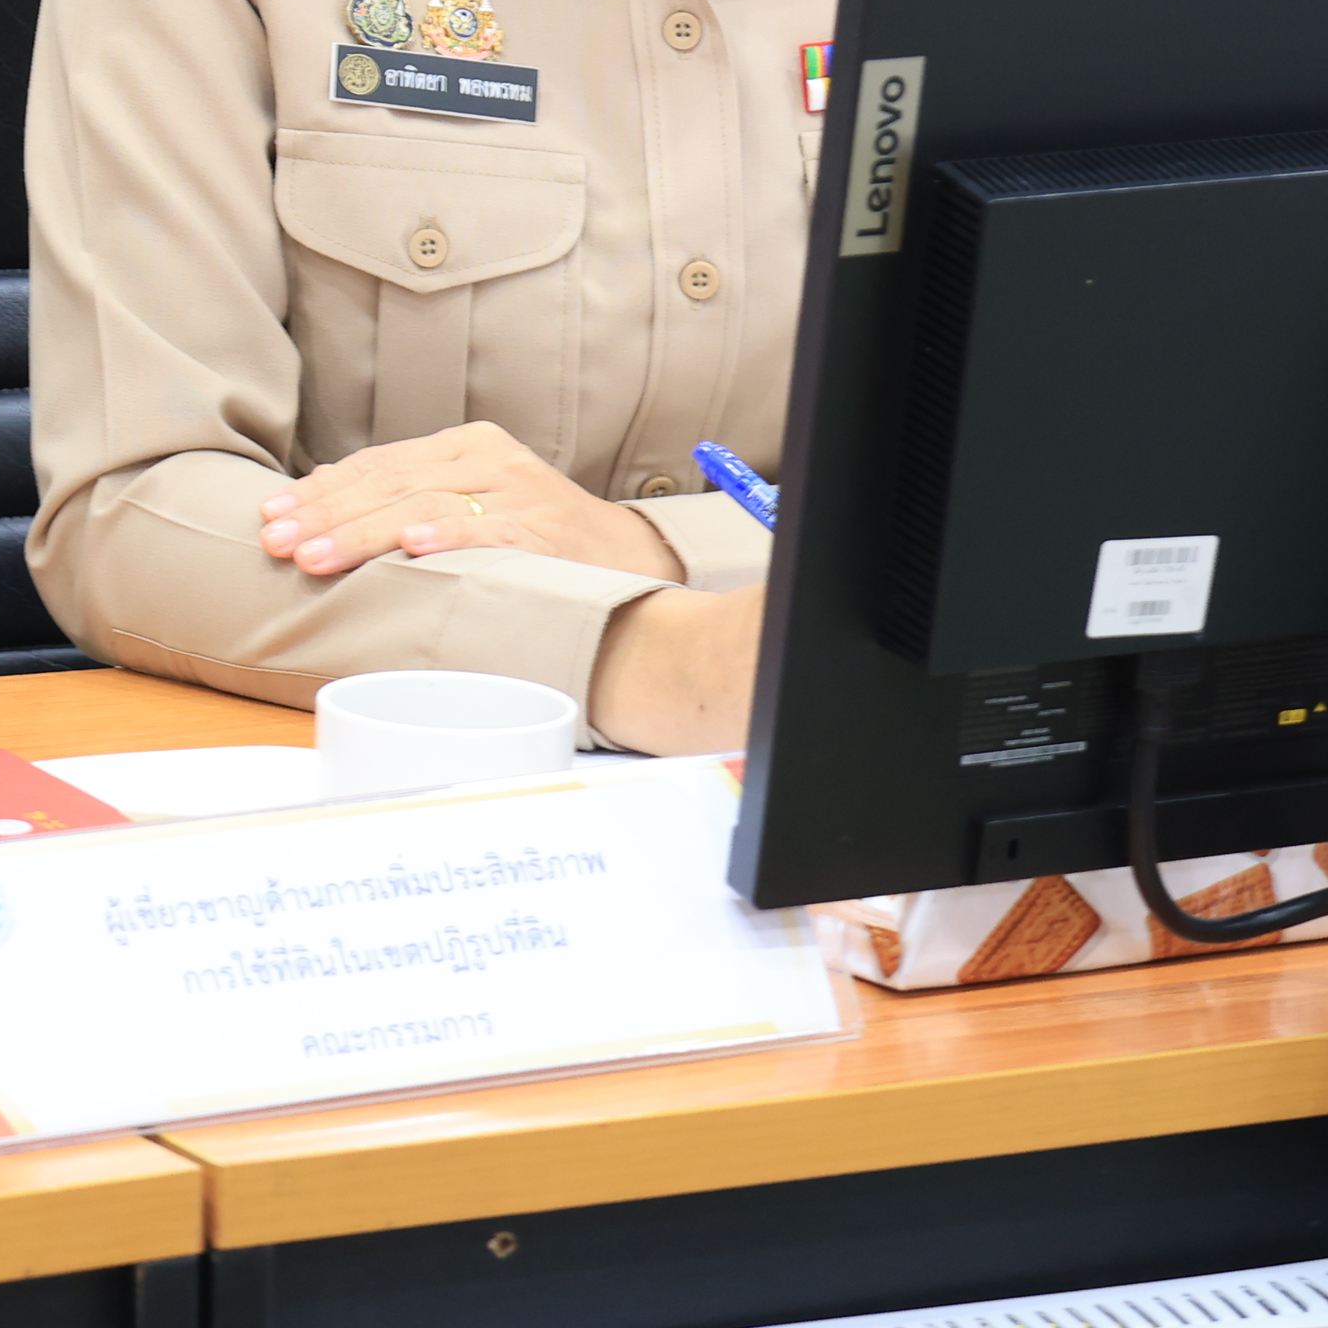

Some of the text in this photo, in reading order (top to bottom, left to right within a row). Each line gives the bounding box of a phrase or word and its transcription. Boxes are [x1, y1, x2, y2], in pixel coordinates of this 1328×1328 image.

[856, 75, 906, 238] Lenovo
[104, 846, 608, 947] ผู้เชี่ยวชาญด้านการเพิ่มประสิทธิภาพ
[182, 907, 569, 994] การใช้ที่ดินในเขตปฏิรูปที่ดิน
[300, 1010, 496, 1060] คณะกรรมการ
